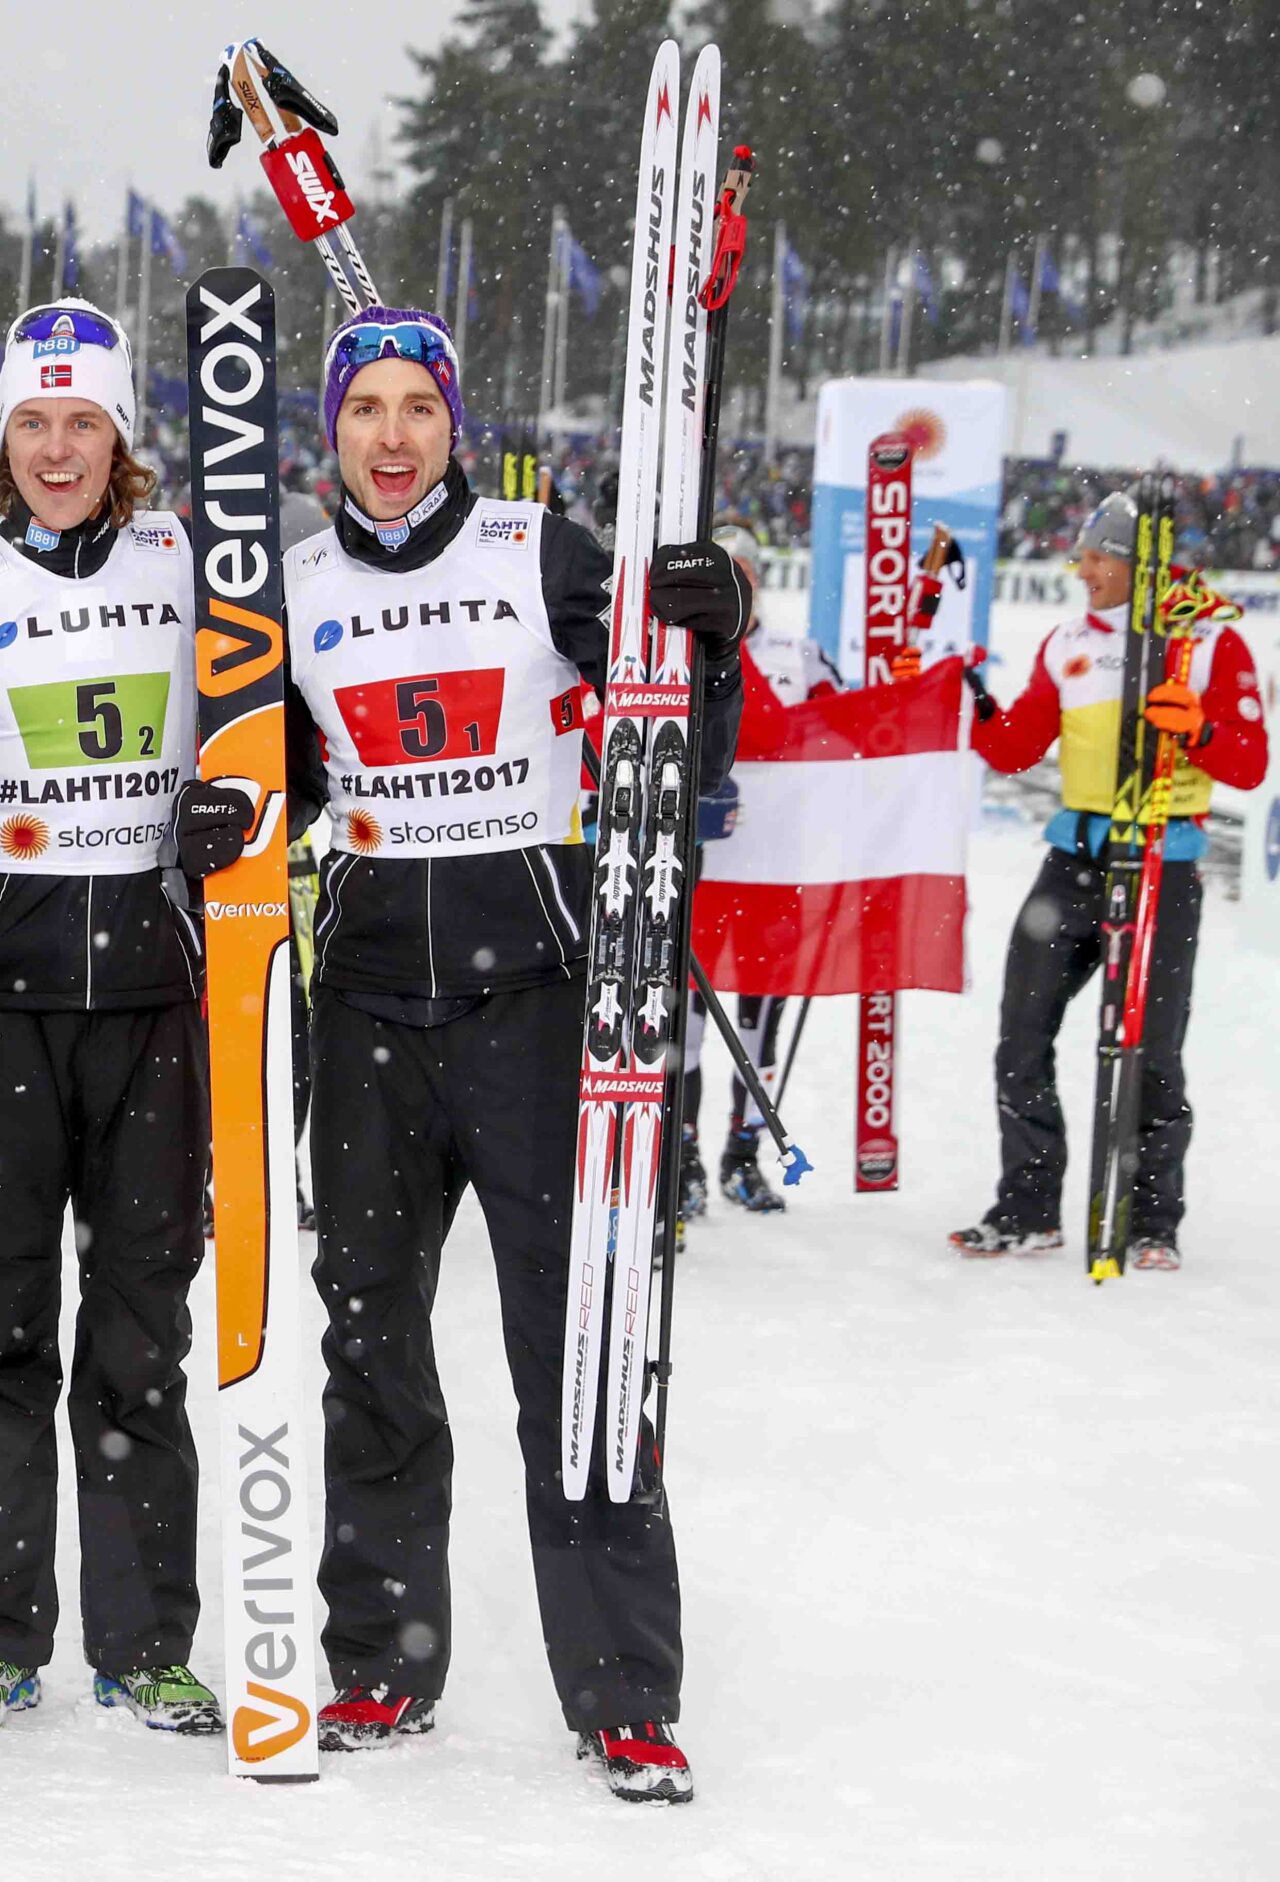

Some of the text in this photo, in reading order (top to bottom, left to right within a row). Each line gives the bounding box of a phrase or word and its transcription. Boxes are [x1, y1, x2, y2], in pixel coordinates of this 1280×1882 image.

[639, 164, 665, 407] MADSHUS
[681, 169, 707, 413] MADSHUS
[37, 339, 75, 353] 1881
[29, 529, 56, 546] 1881
[380, 531, 406, 542] 1881
[480, 529, 511, 540] 2017
[481, 520, 528, 530] LAHTI
[667, 558, 704, 571] CRAFT
[869, 481, 908, 646] SPORT
[27, 603, 182, 638] LUHTA
[351, 599, 518, 638] LUHTA
[395, 679, 481, 758] 5 1
[618, 693, 690, 707] MADSHUS
[76, 682, 154, 759] 5 2
[0, 766, 180, 805] #LAHTI2017
[341, 758, 530, 799] #LAHTI2017
[191, 804, 227, 815] CRAFT
[390, 811, 538, 845] storaenso
[593, 1079, 665, 1094] MADSHUS
[865, 1041, 891, 1129] 2000
[570, 1332, 586, 1469] MADSHUS
[615, 1336, 632, 1474] MADSHUS
